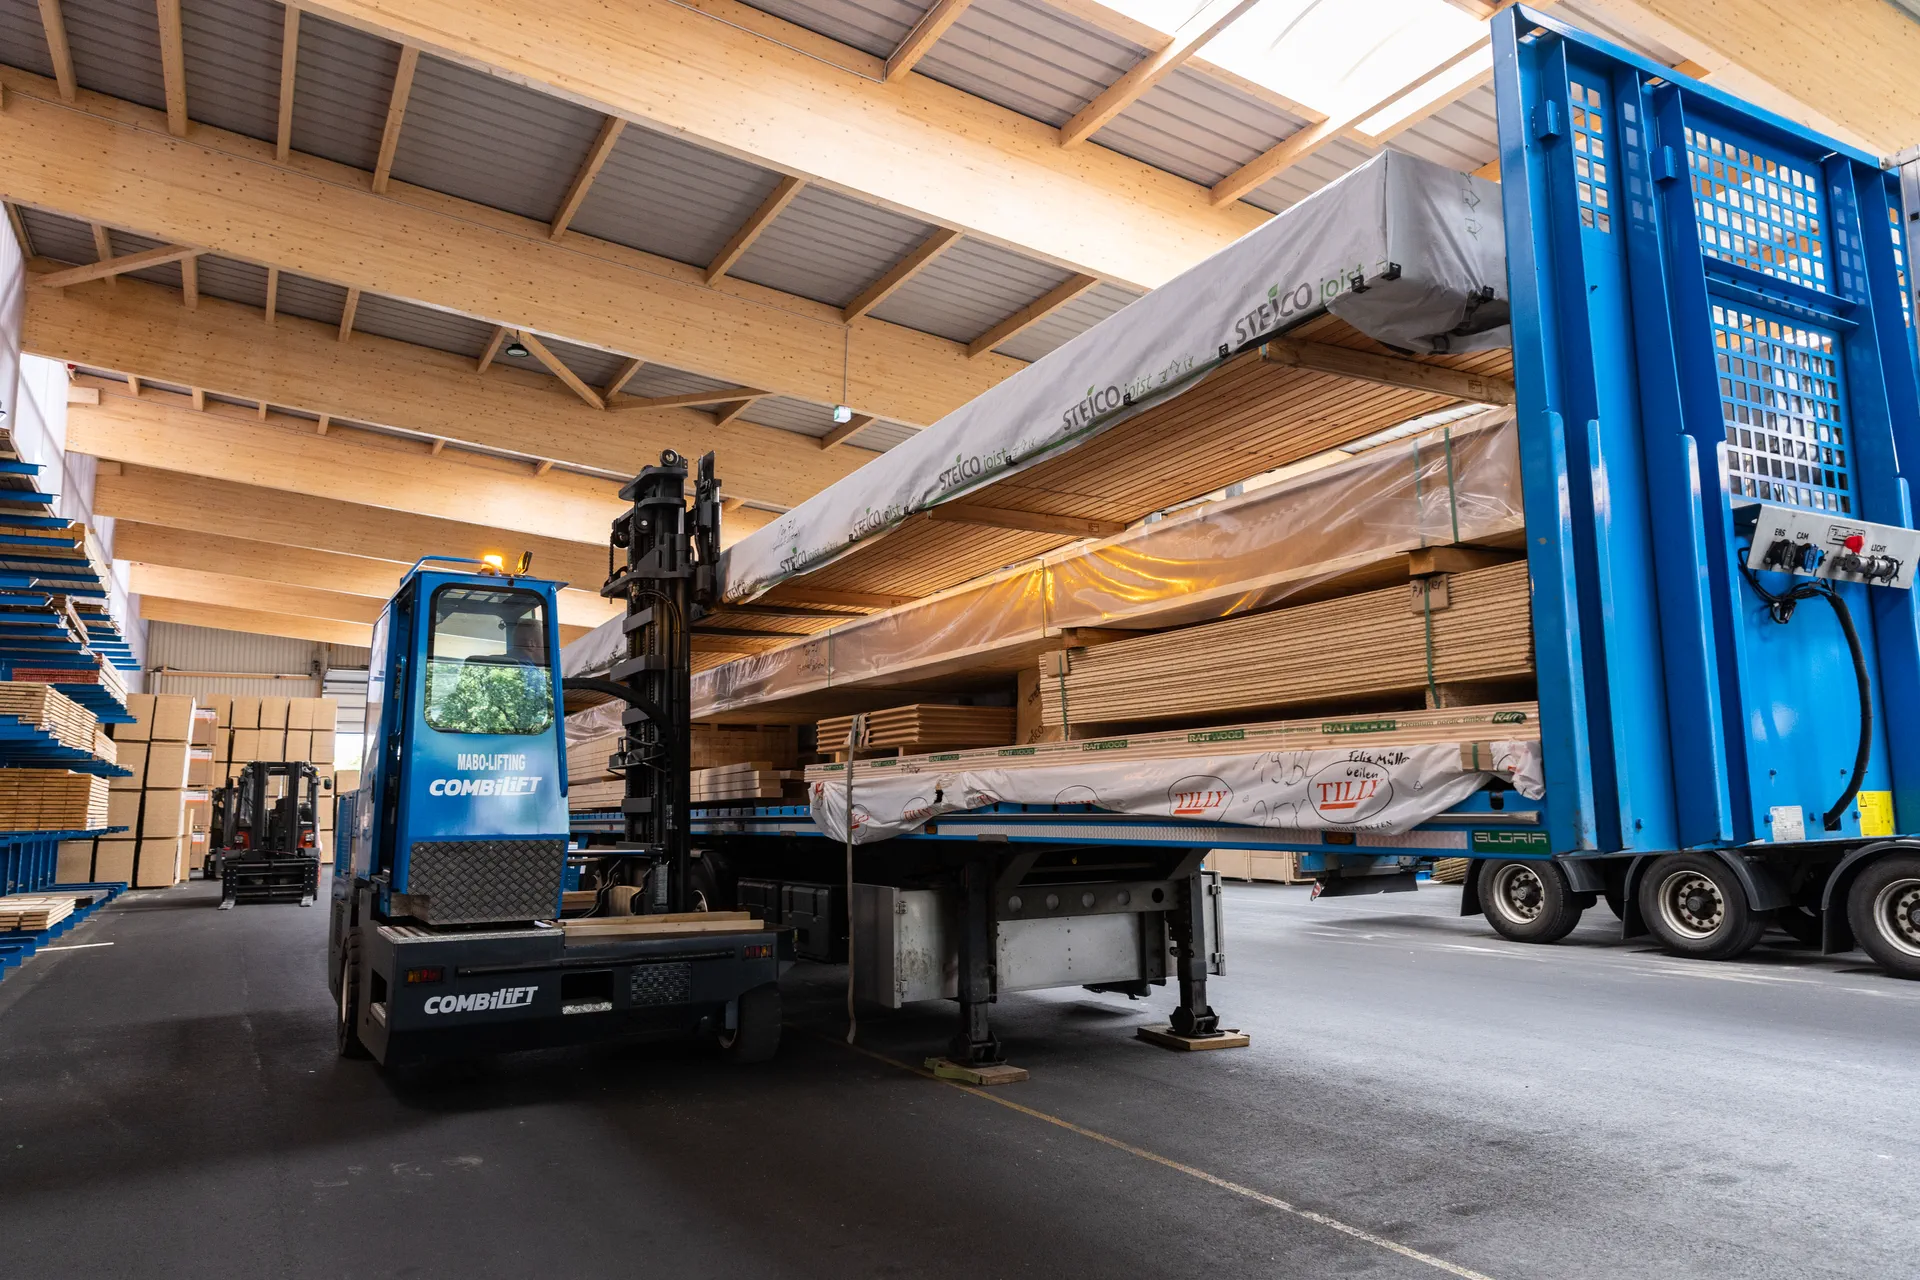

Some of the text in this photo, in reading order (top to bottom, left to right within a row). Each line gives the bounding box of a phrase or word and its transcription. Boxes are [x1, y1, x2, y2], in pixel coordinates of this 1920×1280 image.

[1235, 282, 1313, 345] STEICO
[1063, 384, 1121, 431] STEICO
[939, 453, 981, 491] STEICO
[1796, 531, 1810, 541] CAM
[457, 753, 526, 771] MABO-LIFTING
[1175, 790, 1228, 809] TILLY
[1316, 778, 1384, 803] TILLY
[1474, 832, 1547, 844] GLORIA
